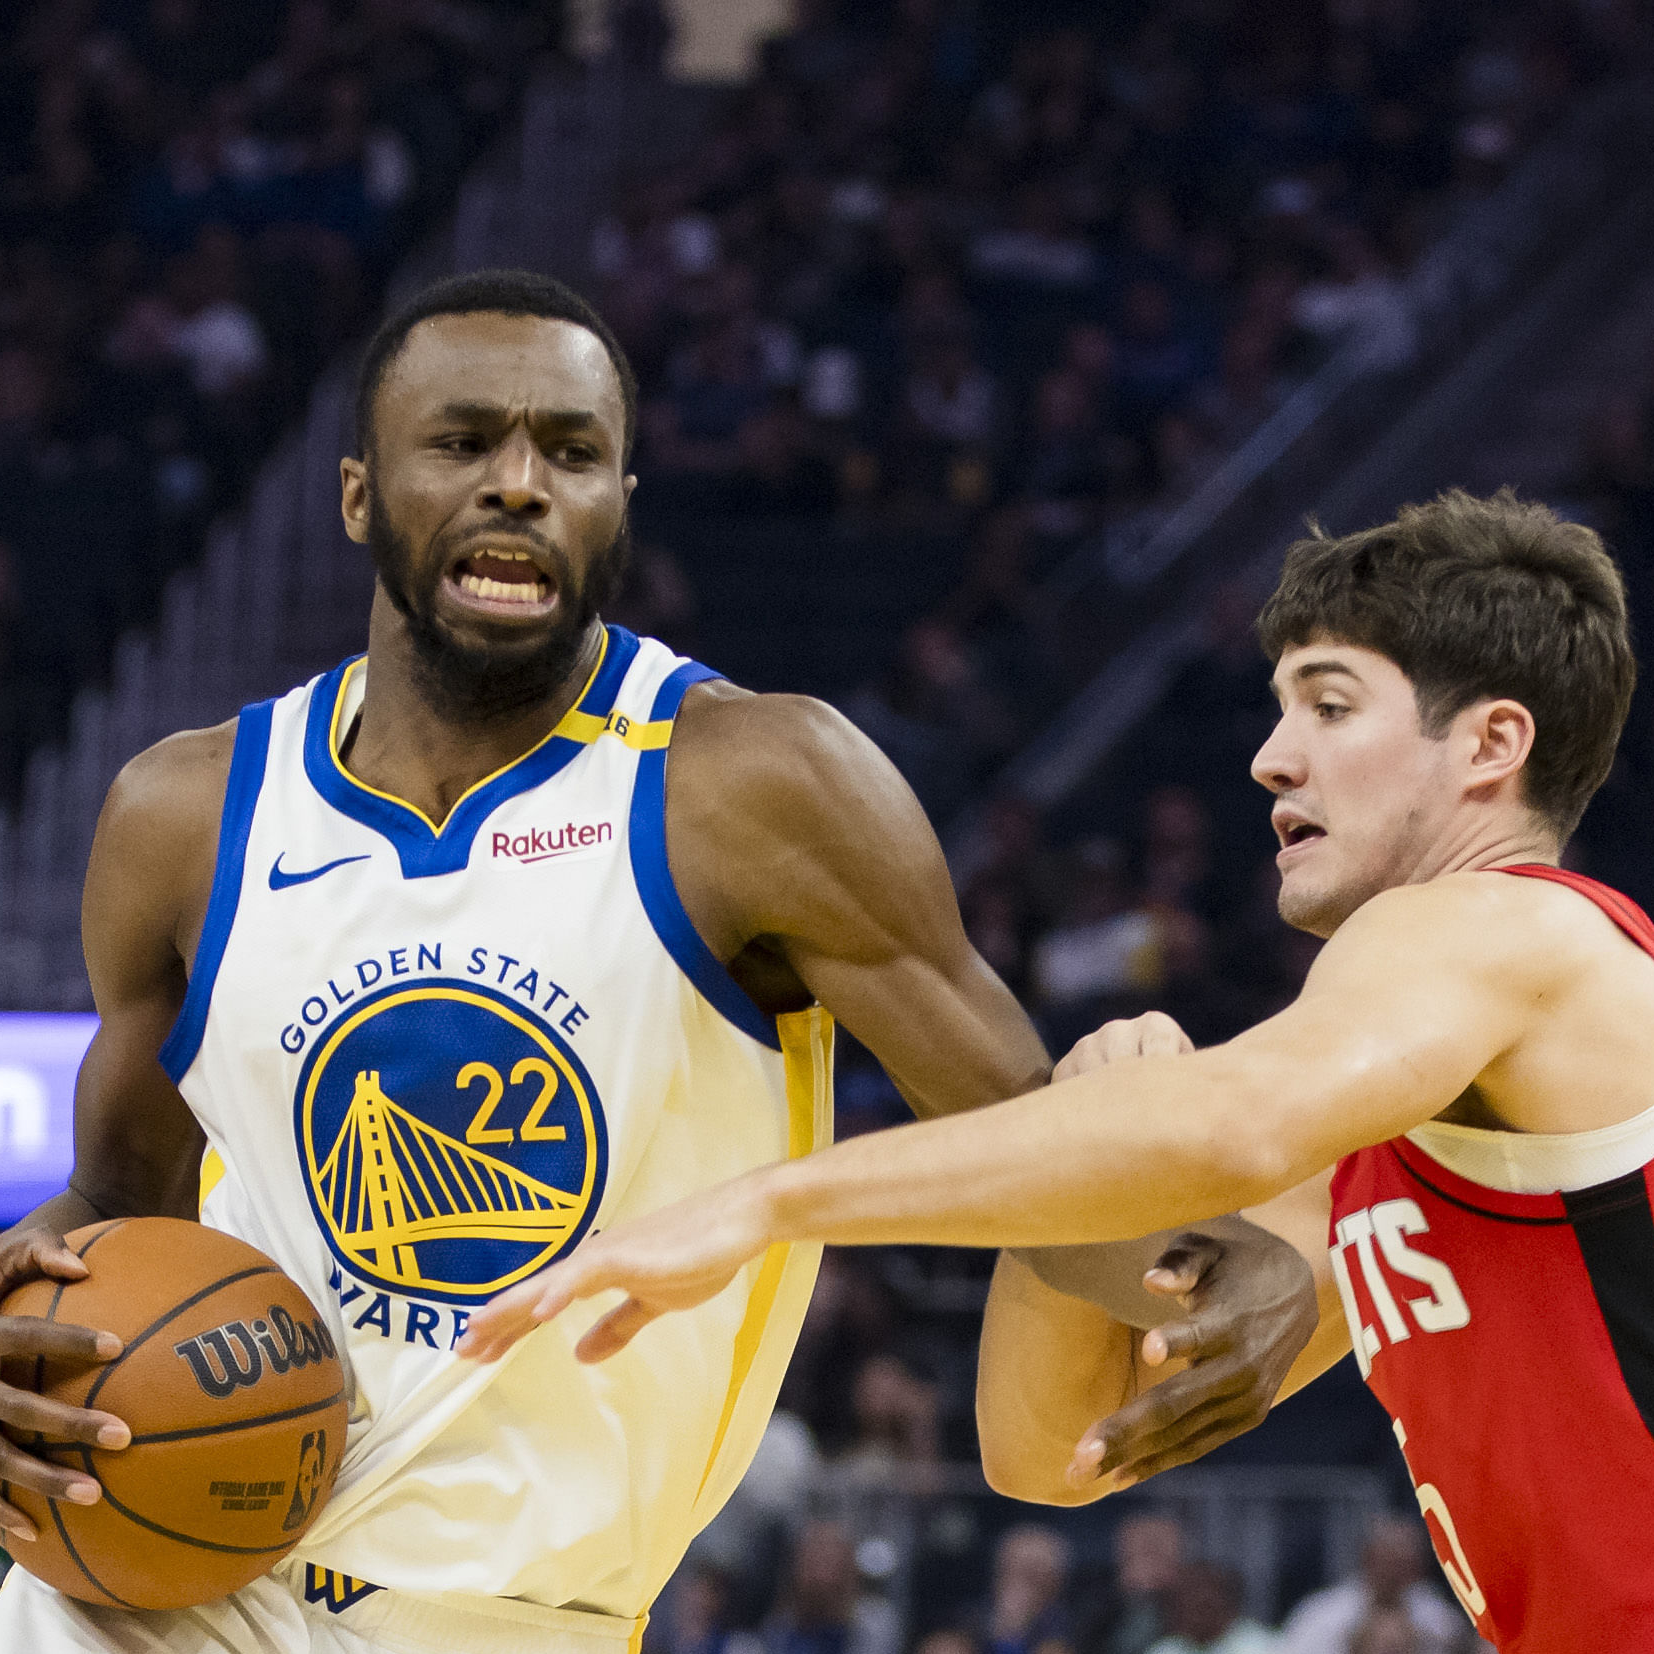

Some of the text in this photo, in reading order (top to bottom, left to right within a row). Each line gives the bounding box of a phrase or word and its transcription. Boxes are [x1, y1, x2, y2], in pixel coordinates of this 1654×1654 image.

[492, 821, 612, 858] Rakuten
[280, 942, 590, 1054] GOLDEN STATE
[455, 1056, 567, 1145] 22
